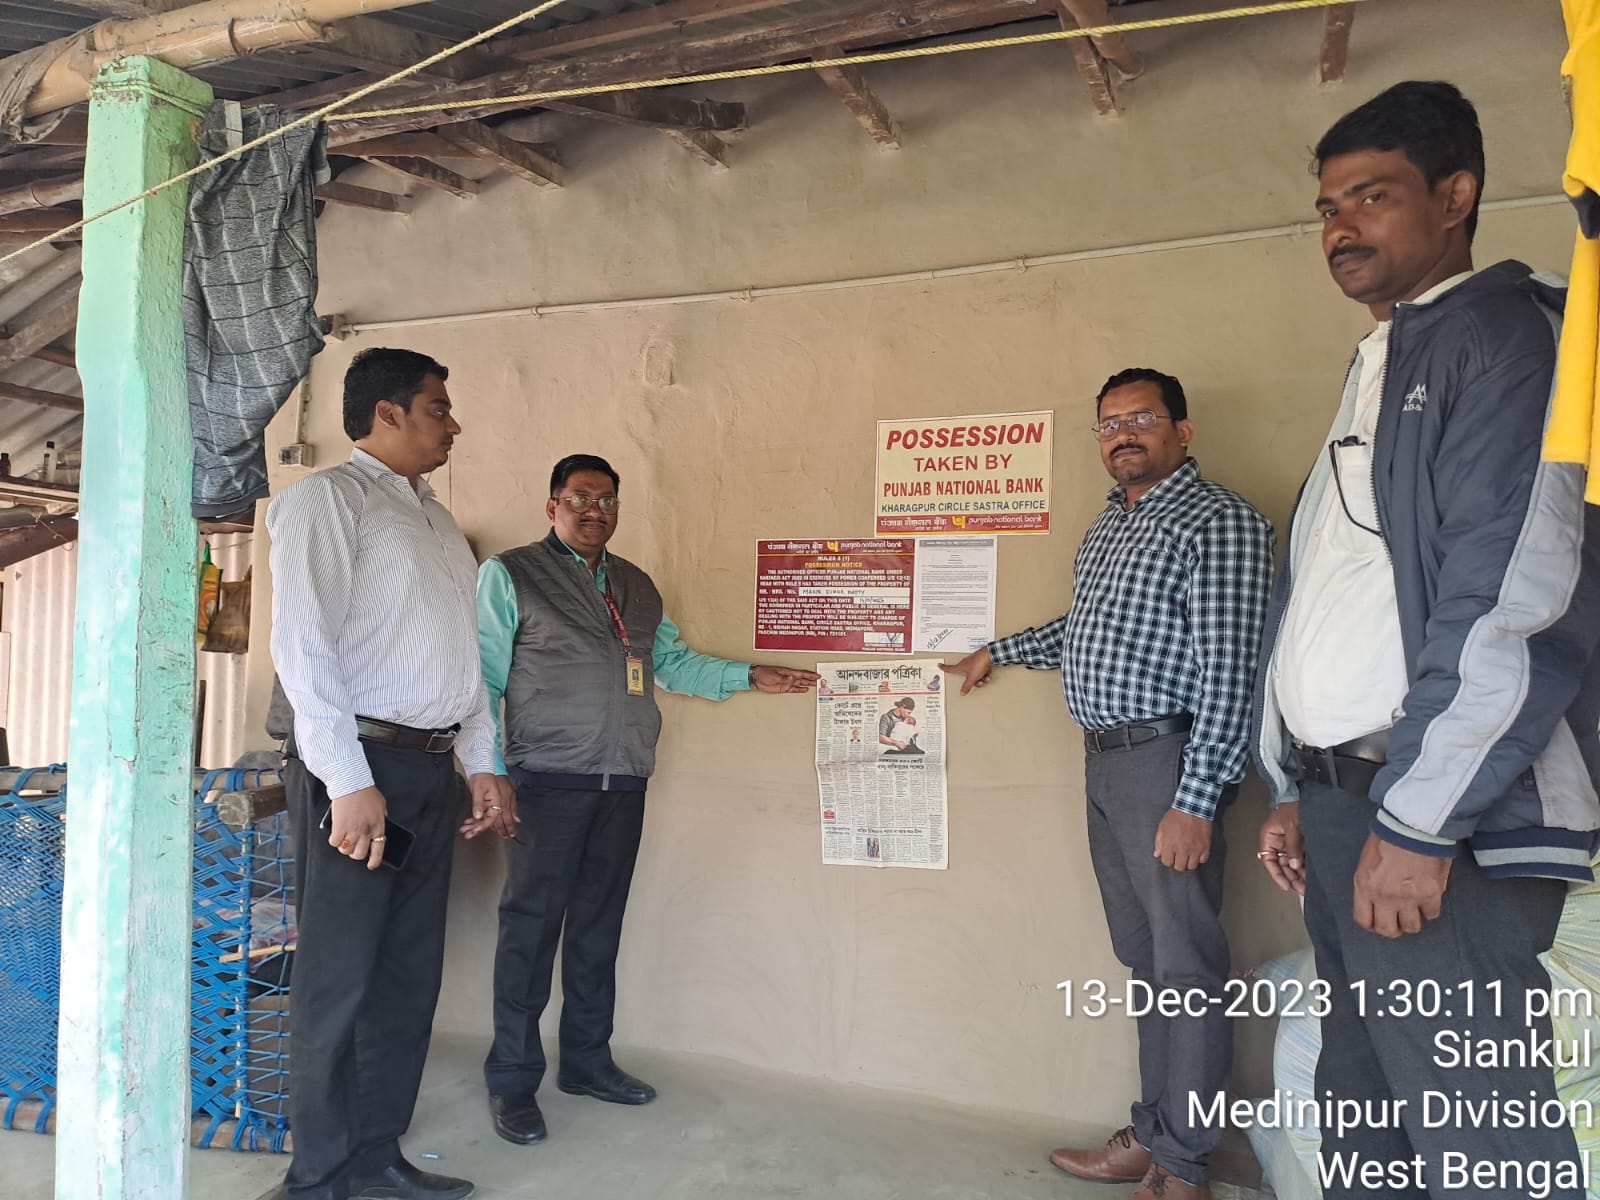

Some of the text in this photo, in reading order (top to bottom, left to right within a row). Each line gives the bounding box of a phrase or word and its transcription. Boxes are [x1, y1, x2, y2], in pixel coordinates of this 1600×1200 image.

[886, 422, 1044, 450] POSSESSION
[914, 454, 1012, 472] TAKEN BY
[884, 478, 1044, 497] PUNJAB NATIONAL BANK
[882, 500, 1045, 512] KHARAGPUR CIRCLE SASTRA OFFICE
[968, 516, 992, 525] punjab
[836, 665, 922, 680] আনন্দবাজার পত্রিকা
